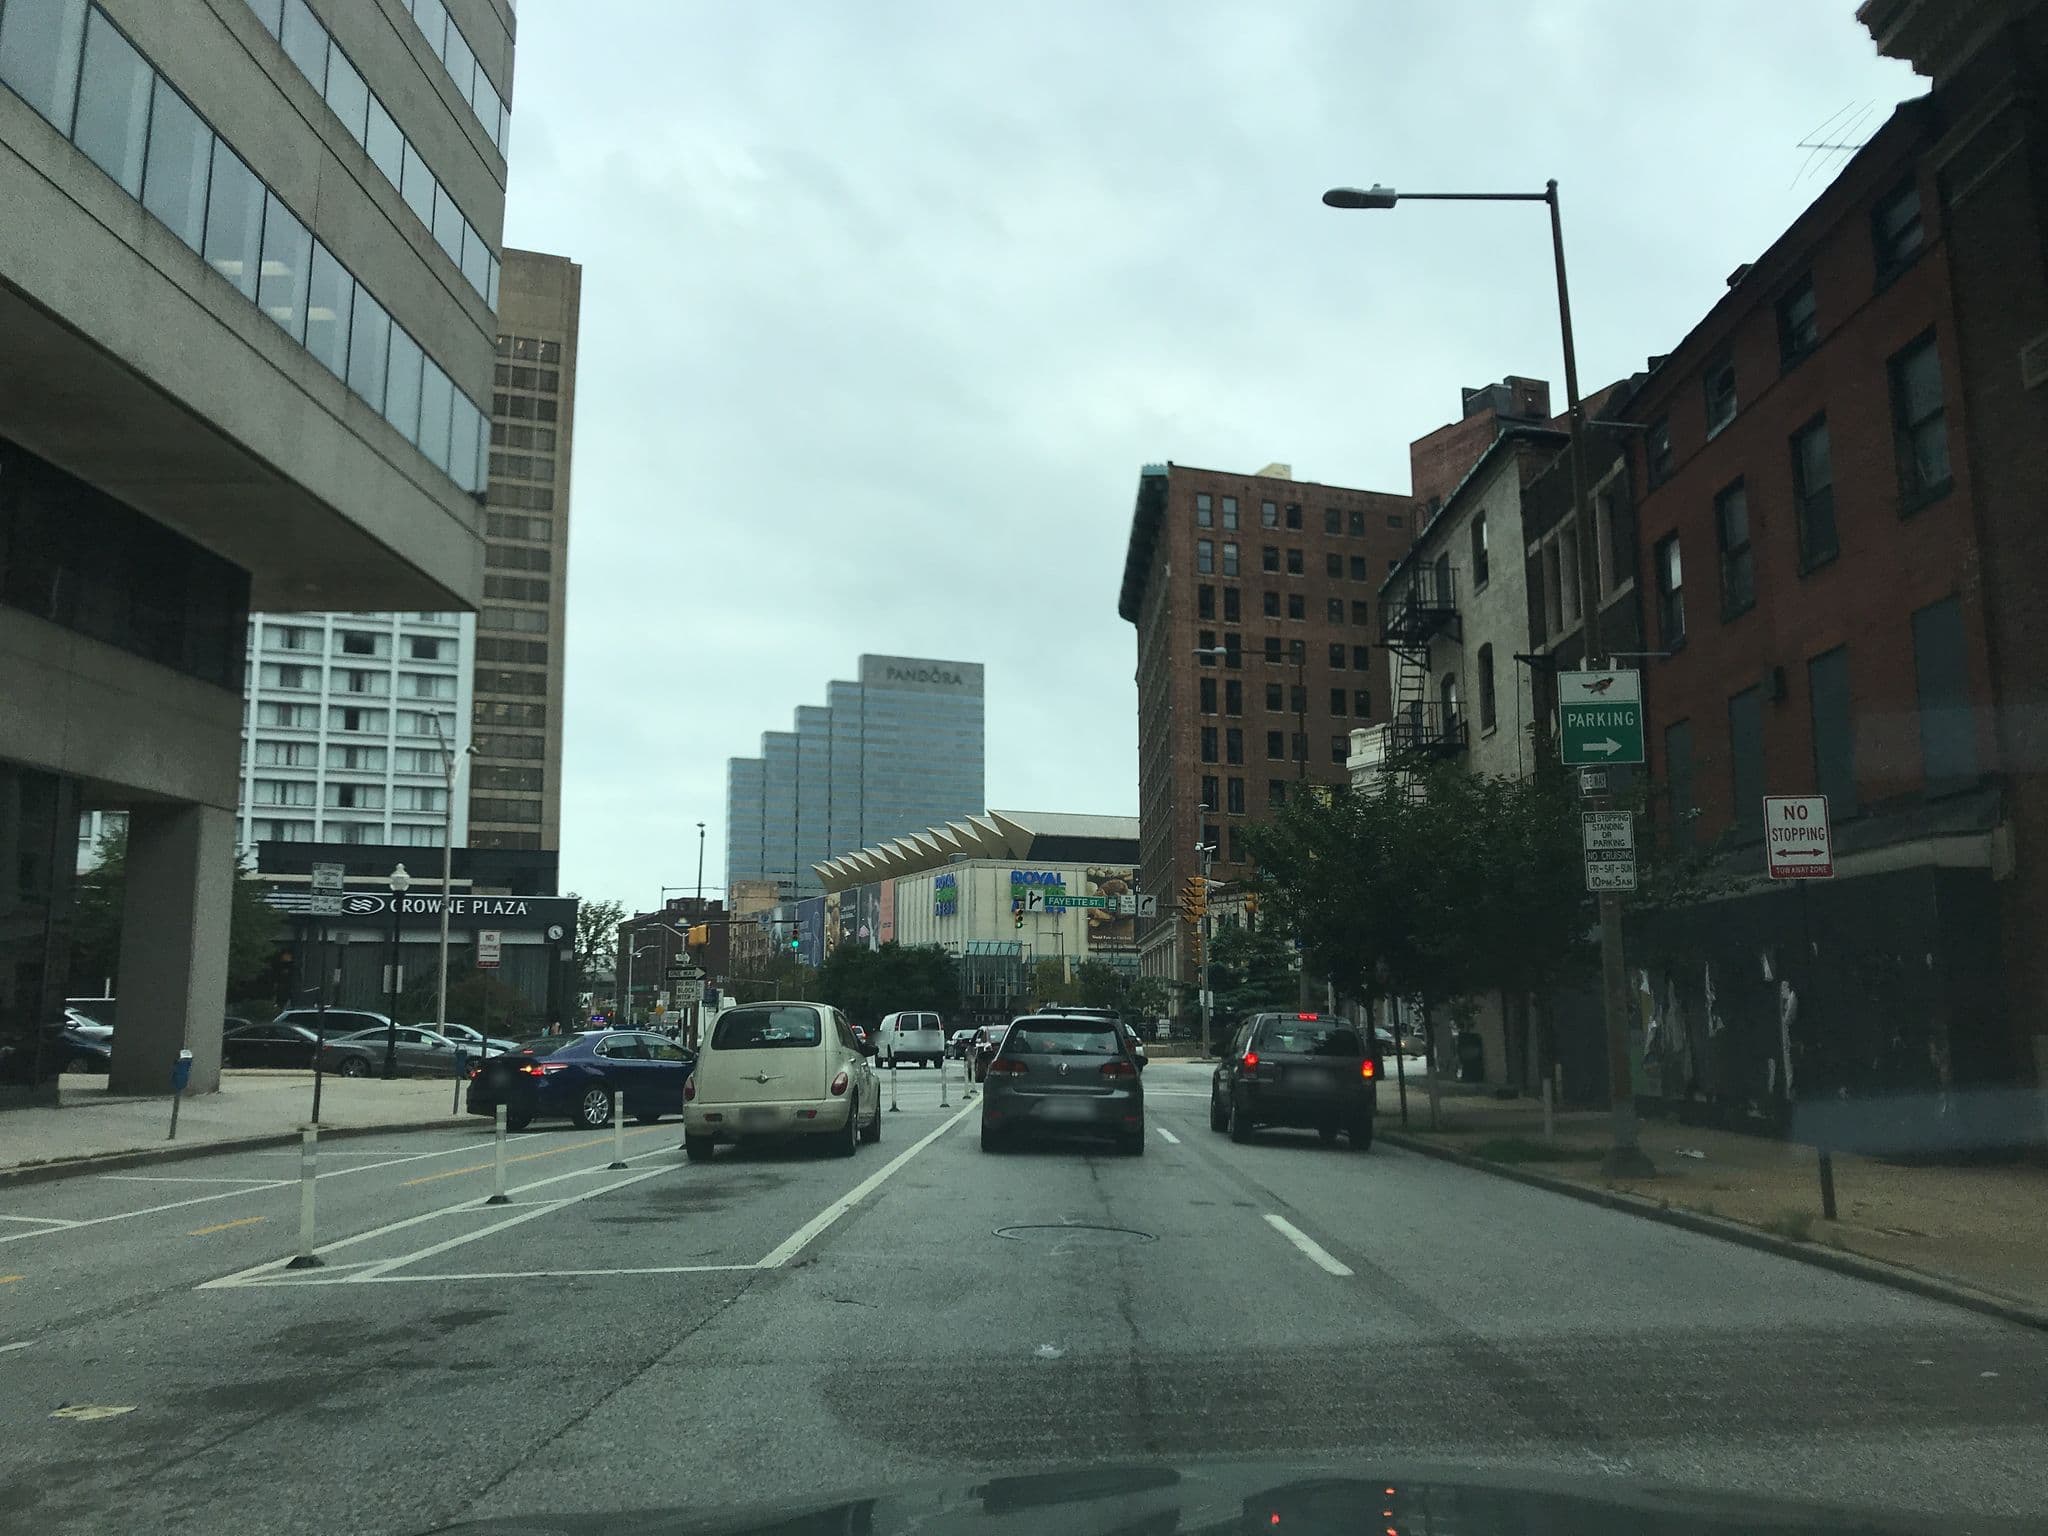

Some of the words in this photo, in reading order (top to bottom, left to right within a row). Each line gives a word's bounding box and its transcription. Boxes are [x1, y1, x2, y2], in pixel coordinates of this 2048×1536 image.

[1567, 711, 1635, 728] PARKING
[1597, 814, 1630, 822] STOPPING
[1784, 805, 1808, 820] NO
[1592, 823, 1625, 831] STANDING
[1771, 827, 1826, 842] STOPPING
[1593, 839, 1626, 847] PARKING
[1587, 852, 1598, 860] NO
[1601, 851, 1633, 860] CRUISING
[1011, 870, 1067, 885] ROYAL
[1048, 896, 1089, 906] FAYETTE
[473, 900, 527, 915] PLAZA
